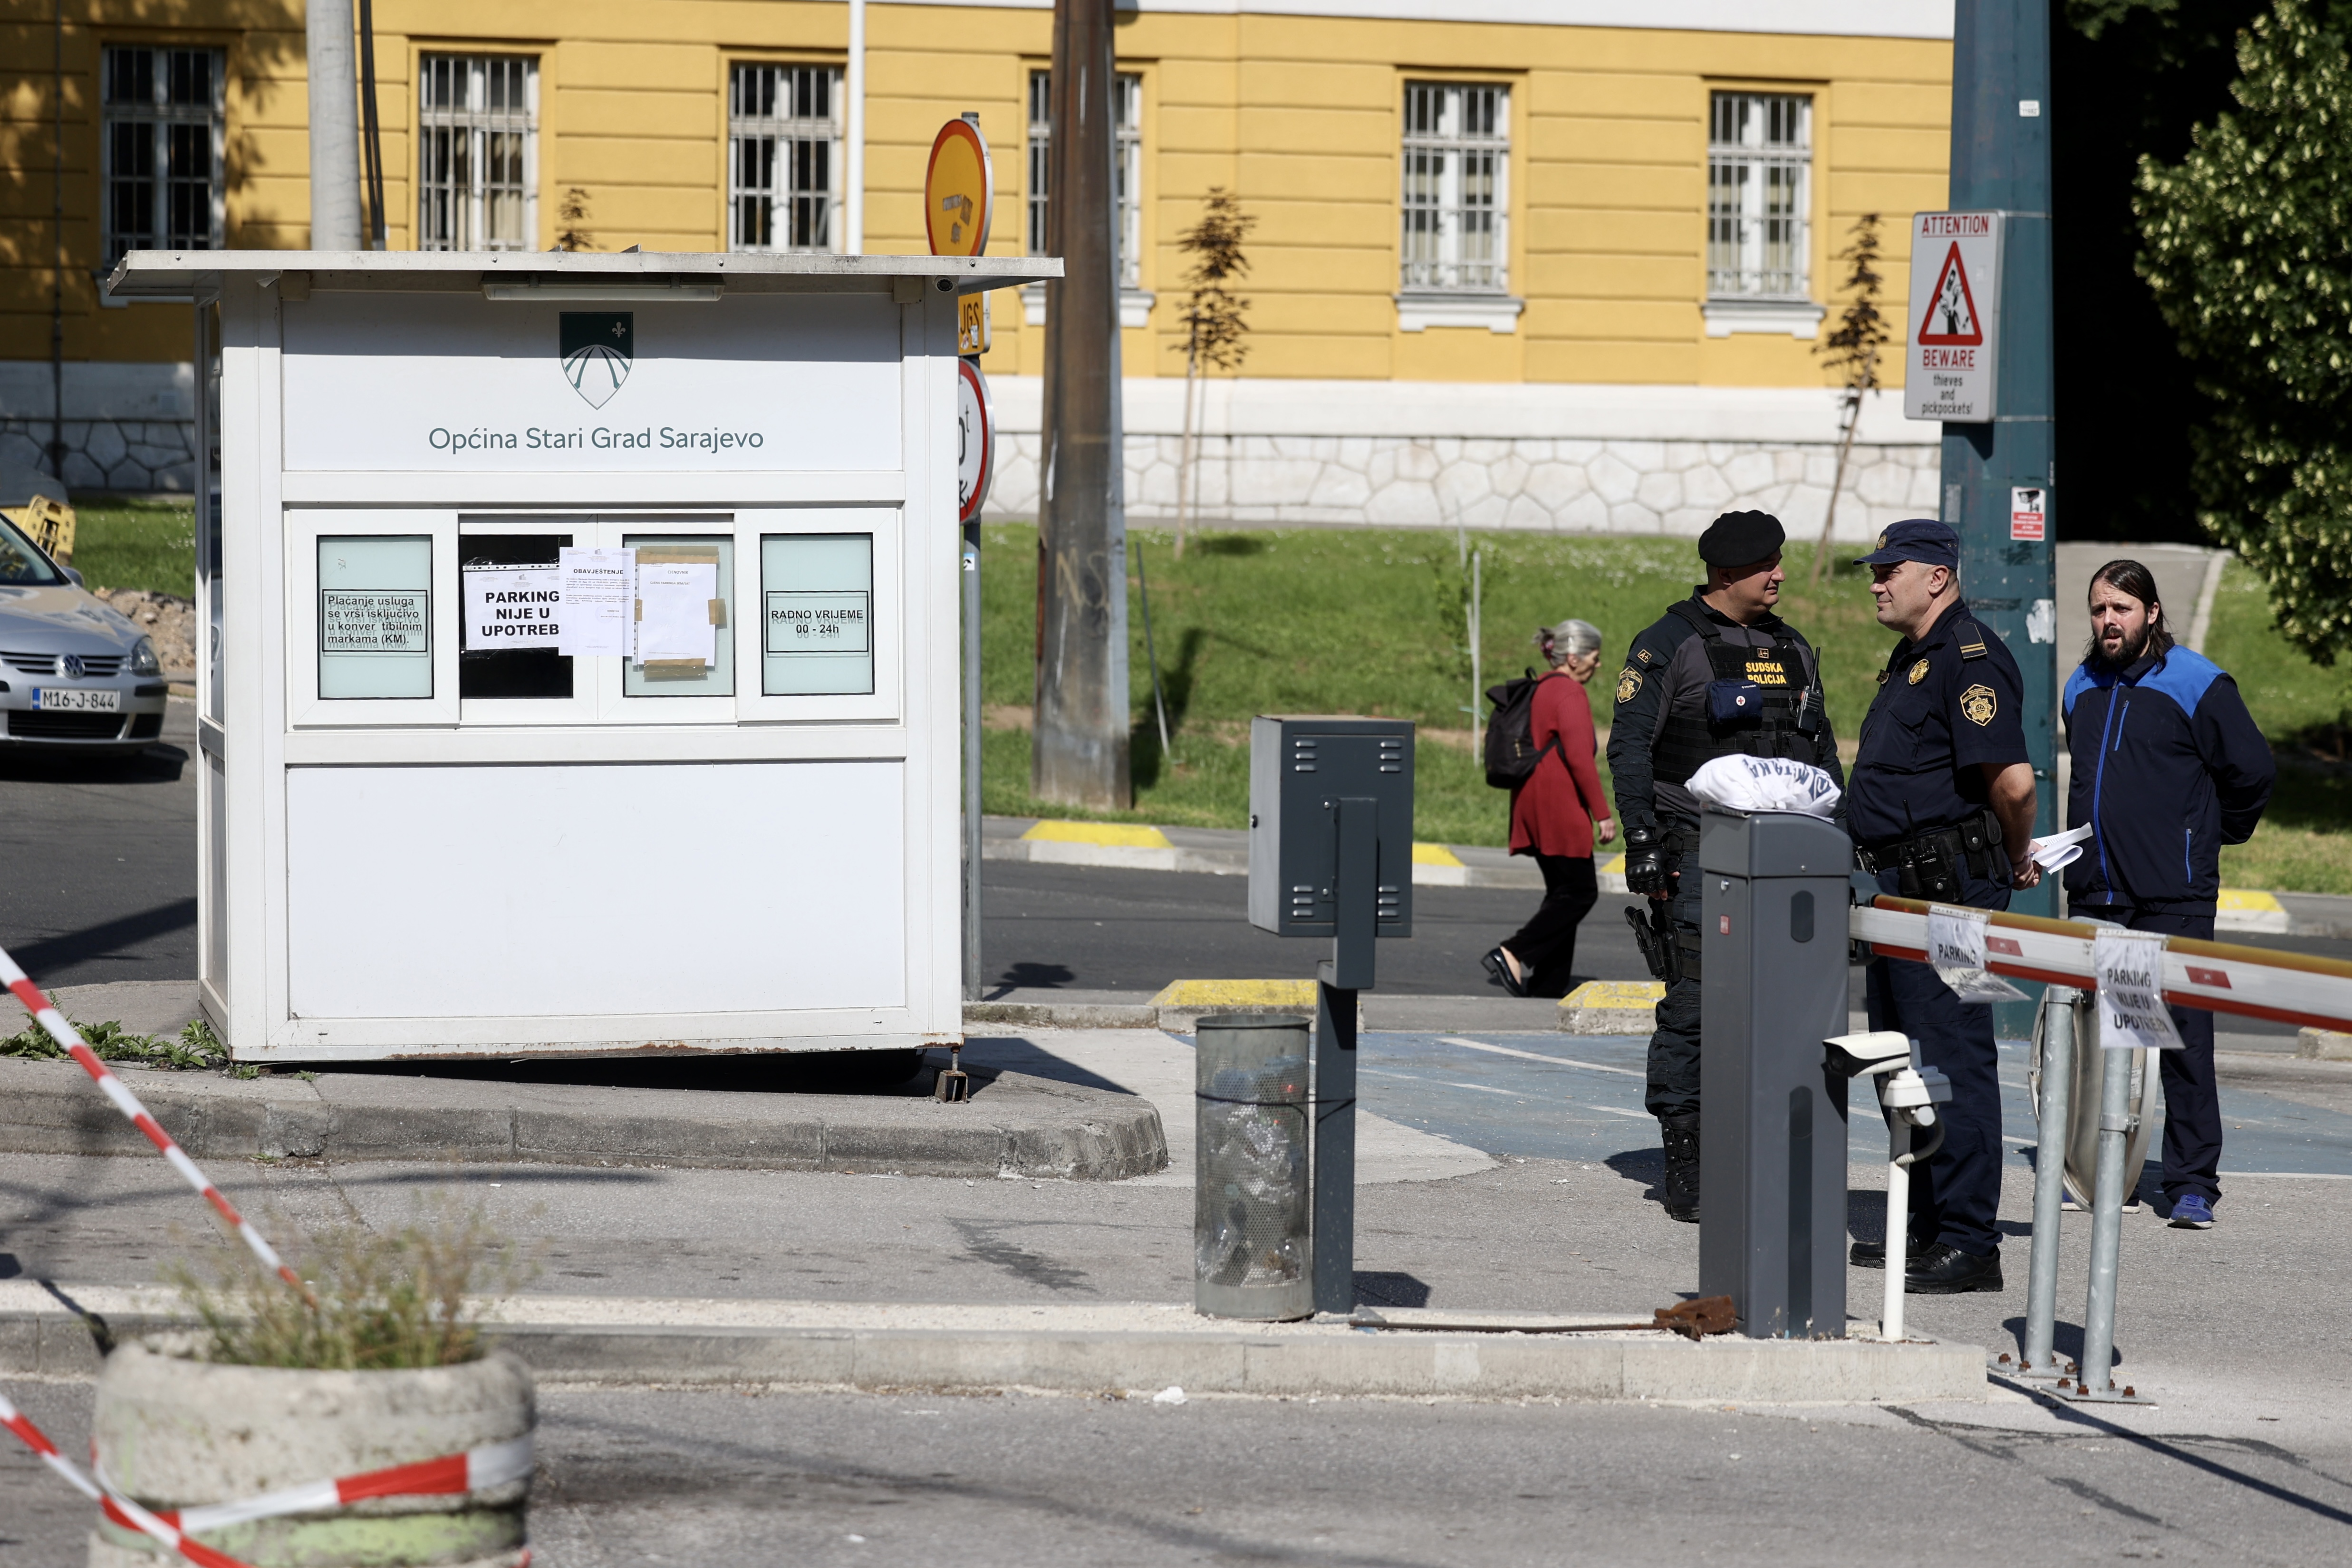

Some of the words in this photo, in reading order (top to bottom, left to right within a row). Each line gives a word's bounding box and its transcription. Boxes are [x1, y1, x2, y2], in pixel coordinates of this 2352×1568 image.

[1922, 215, 1989, 234] ATTENTION
[1923, 349, 1975, 367] BEWARE
[1933, 374, 1963, 386] thieves
[1940, 388, 1955, 400] and
[1922, 401, 1973, 416] pickpockets!
[429, 427, 518, 454] Općina
[526, 427, 583, 449] Stari
[591, 427, 651, 449] Grad
[659, 427, 764, 454] Sarajevo
[328, 596, 374, 607] Plaćanje
[378, 596, 414, 607] usluga
[485, 591, 559, 604] PARKING
[344, 609, 364, 617] vrši
[367, 609, 419, 620] isključivo
[496, 608, 533, 620] NIJE
[539, 607, 550, 619] U
[771, 610, 812, 619] RADNO
[815, 610, 863, 619] VRIJEME
[338, 622, 376, 630] konver
[382, 622, 422, 631] tibilnim
[796, 625, 809, 633] 00
[819, 624, 839, 633] 24h
[328, 635, 377, 643] markama
[381, 635, 409, 645] (KM).
[1745, 662, 1784, 673] SUDSKA
[1747, 674, 1787, 684] POLICIJA
[43, 691, 114, 710] M16-J-844
[1938, 944, 1976, 964] PARKING
[2107, 968, 2151, 987] PARKING
